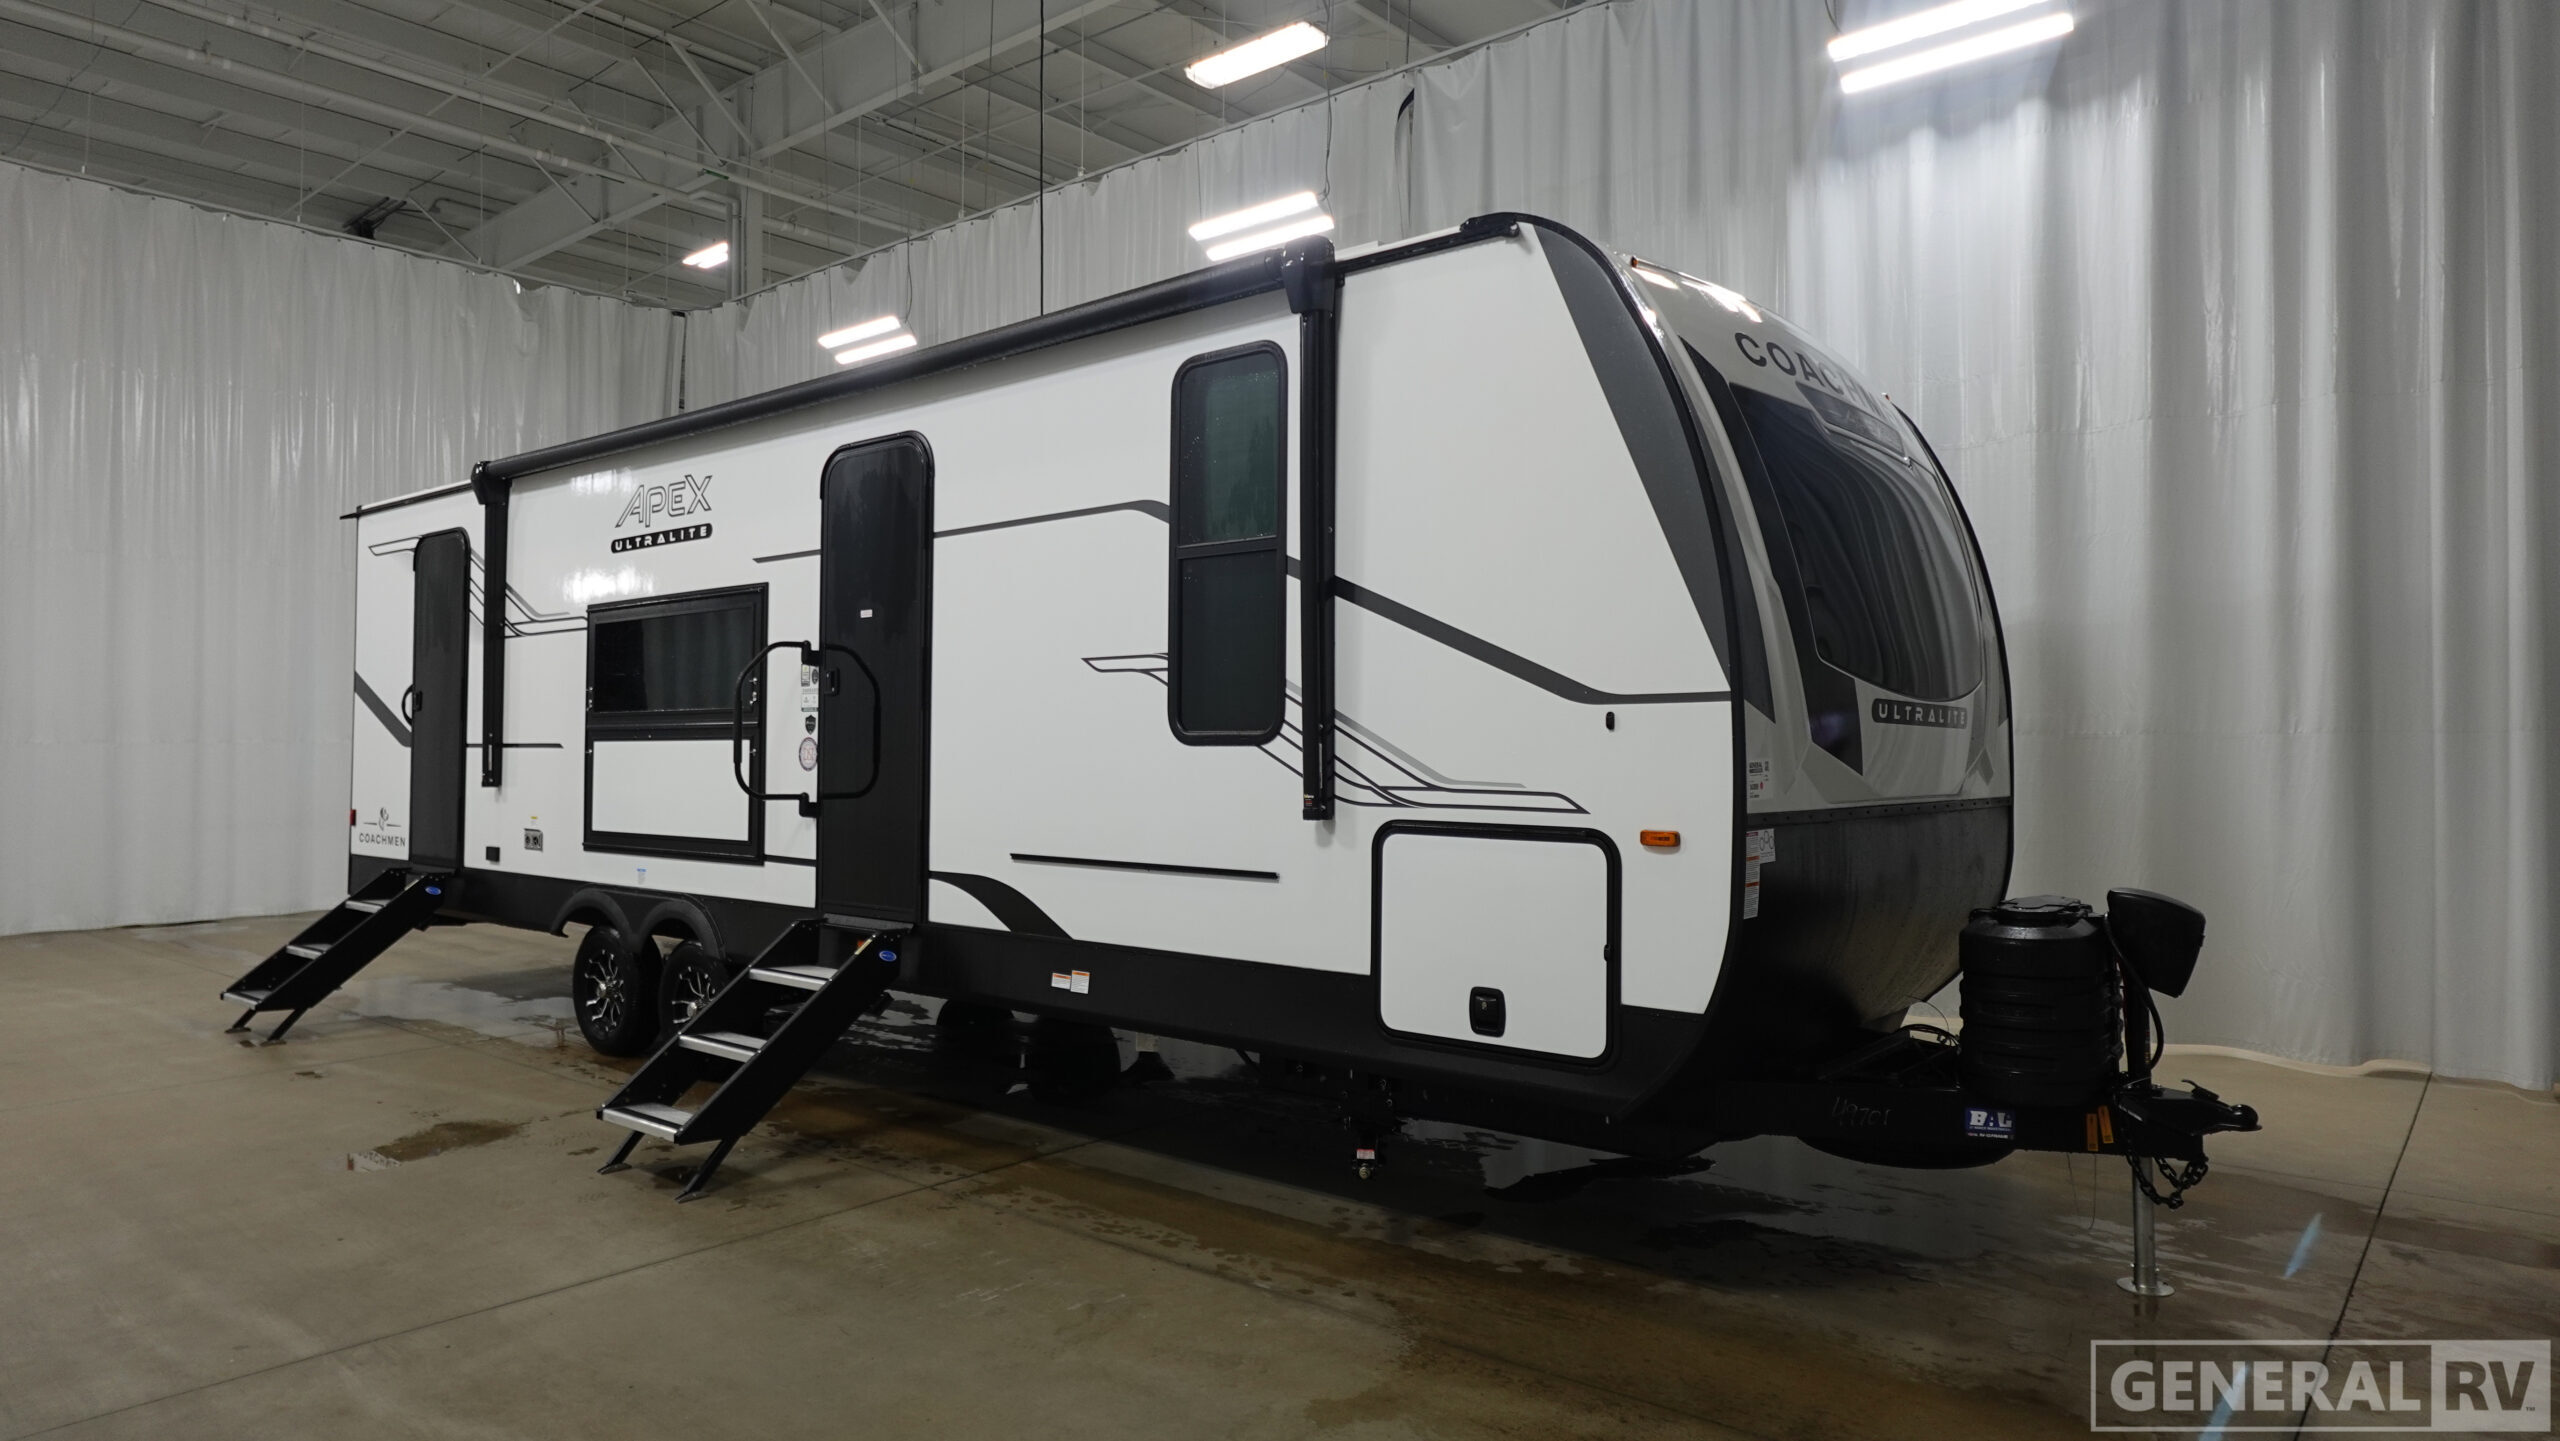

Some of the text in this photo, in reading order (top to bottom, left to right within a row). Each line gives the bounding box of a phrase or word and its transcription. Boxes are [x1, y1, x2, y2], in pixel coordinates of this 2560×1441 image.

[615, 474, 713, 528] APEX
[615, 526, 708, 551] ULTRALITE
[1878, 703, 1966, 725] ULTRALITE
[359, 832, 406, 847] COACHMEN
